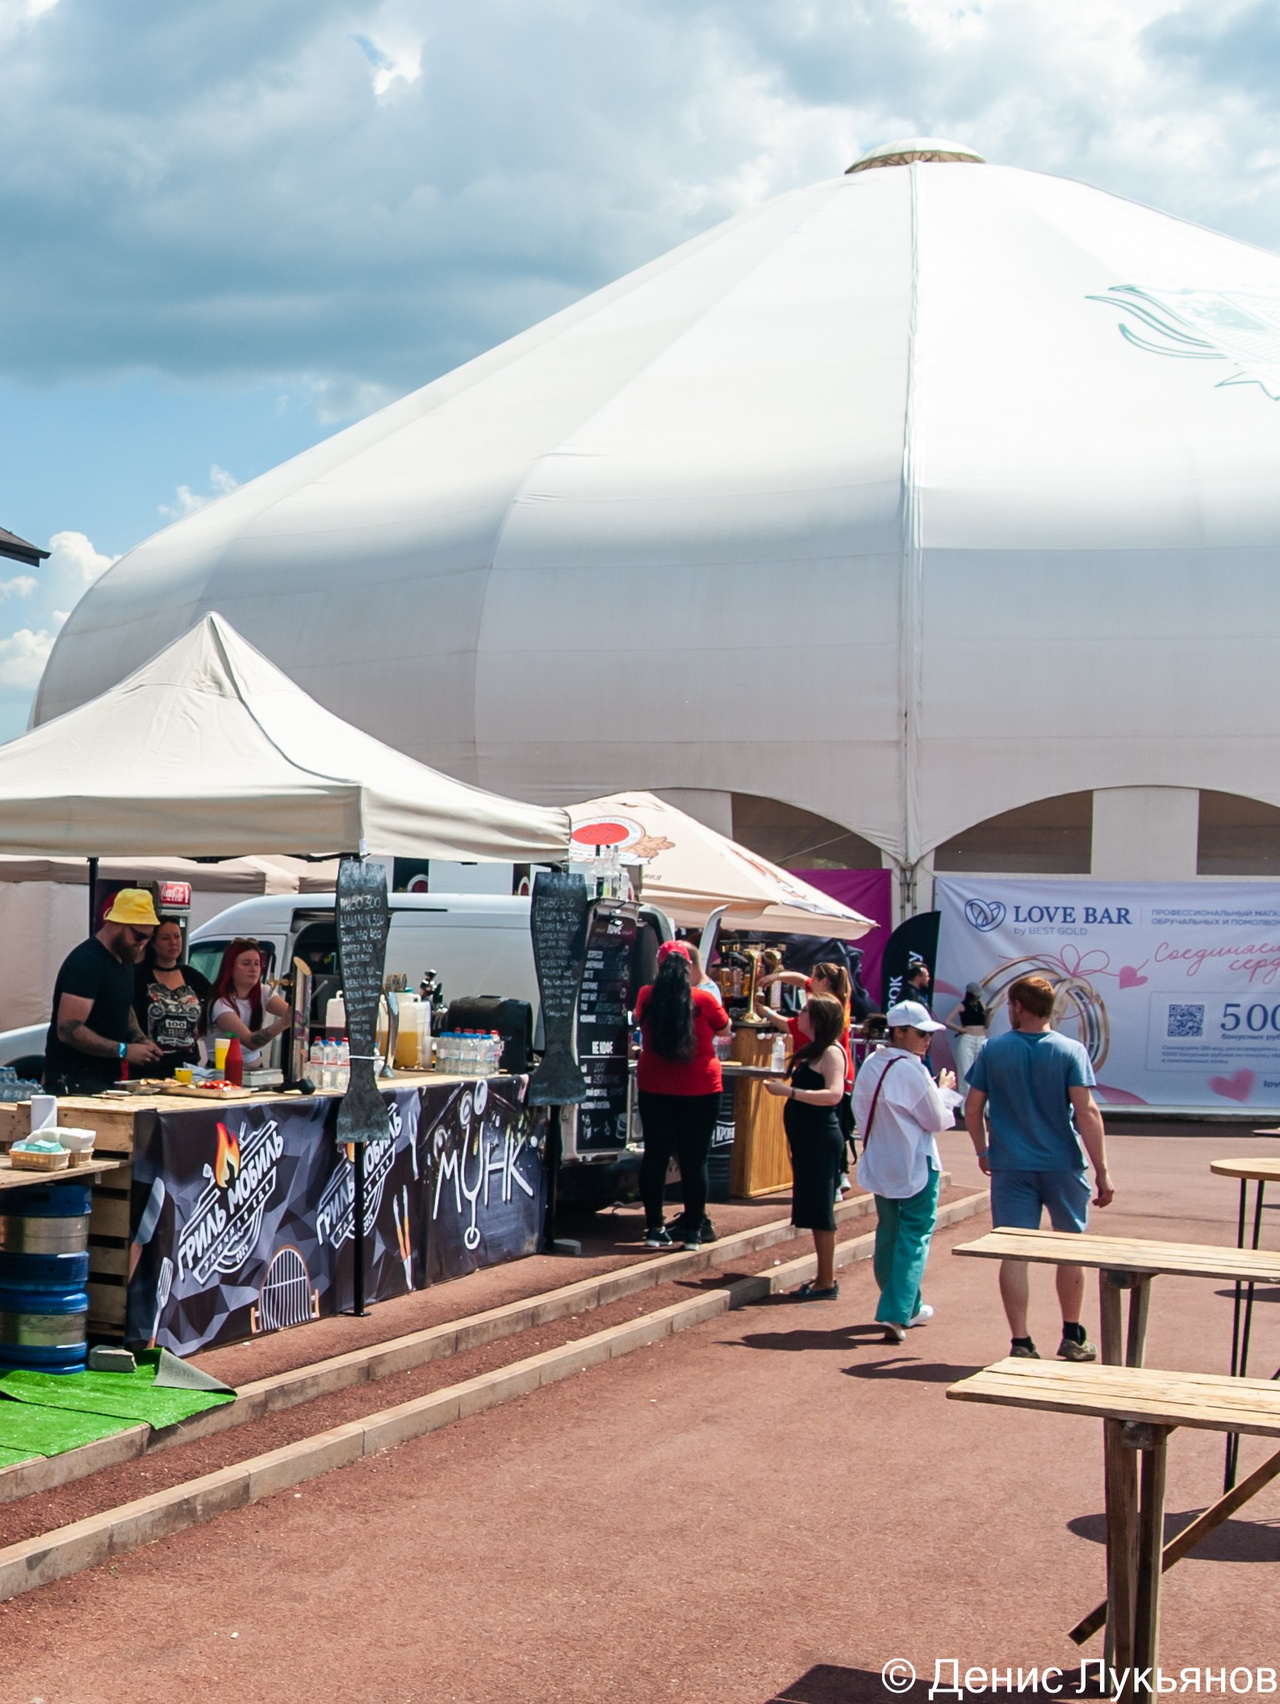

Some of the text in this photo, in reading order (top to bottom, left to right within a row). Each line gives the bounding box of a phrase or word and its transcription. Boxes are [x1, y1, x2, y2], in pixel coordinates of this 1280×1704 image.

[1013, 905, 1133, 925] LOVE BAR
[1151, 908, 1253, 917] ПРОФЕССИОНАЛЬНЫЙ
[1151, 918, 1220, 926] ОБРУЧАЛЬНЫХ
[1014, 927, 1088, 936] by BEST GOLD
[177, 1130, 284, 1282] ГРИЛЬ МОБИЛЬ
